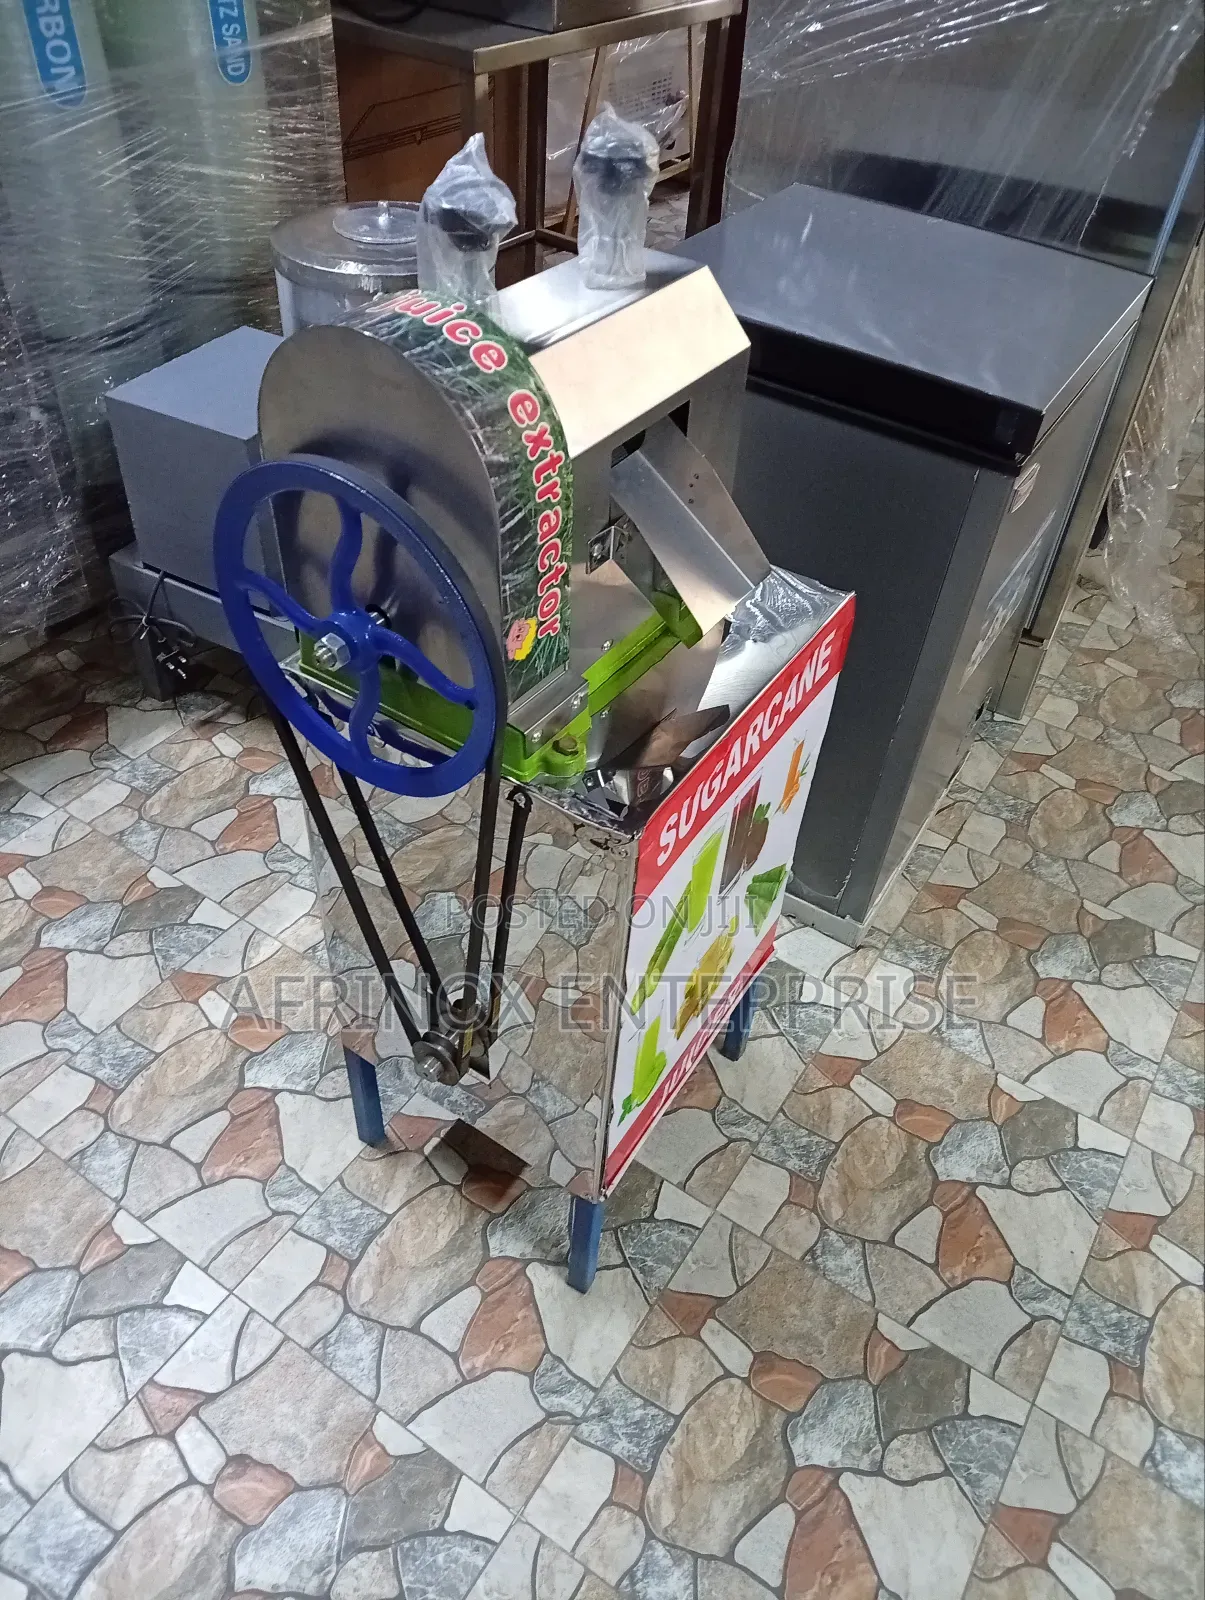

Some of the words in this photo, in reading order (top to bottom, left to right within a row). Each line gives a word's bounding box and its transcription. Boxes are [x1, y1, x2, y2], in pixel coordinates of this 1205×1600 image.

[221, 23, 245, 76] SAND
[365, 289, 508, 373] juice
[507, 389, 568, 639] extractor
[656, 628, 837, 867] SUGARCANE
